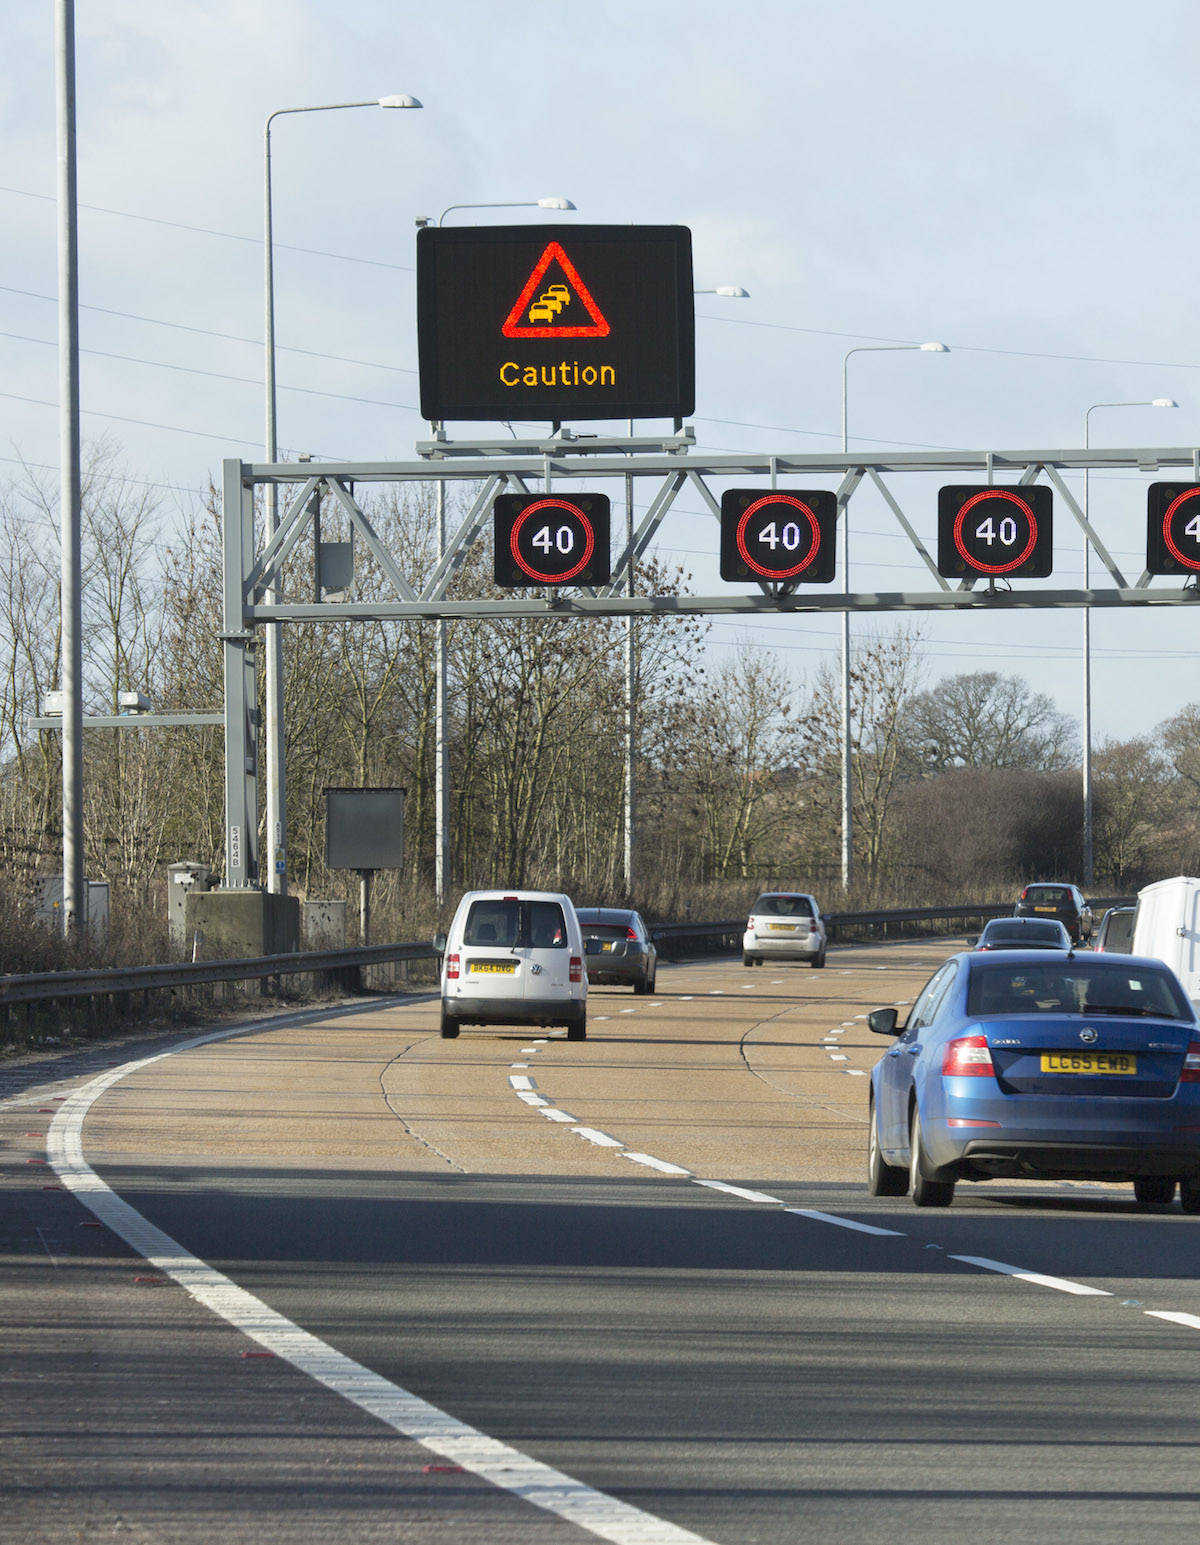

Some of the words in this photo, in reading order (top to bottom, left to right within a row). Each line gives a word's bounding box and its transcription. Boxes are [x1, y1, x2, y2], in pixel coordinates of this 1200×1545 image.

[499, 361, 616, 387] Caution
[533, 526, 573, 554] 40
[759, 522, 799, 550] 40
[976, 518, 1016, 545] 40
[1048, 1056, 1093, 1070] LC65
[1096, 1056, 1130, 1072] EWD
